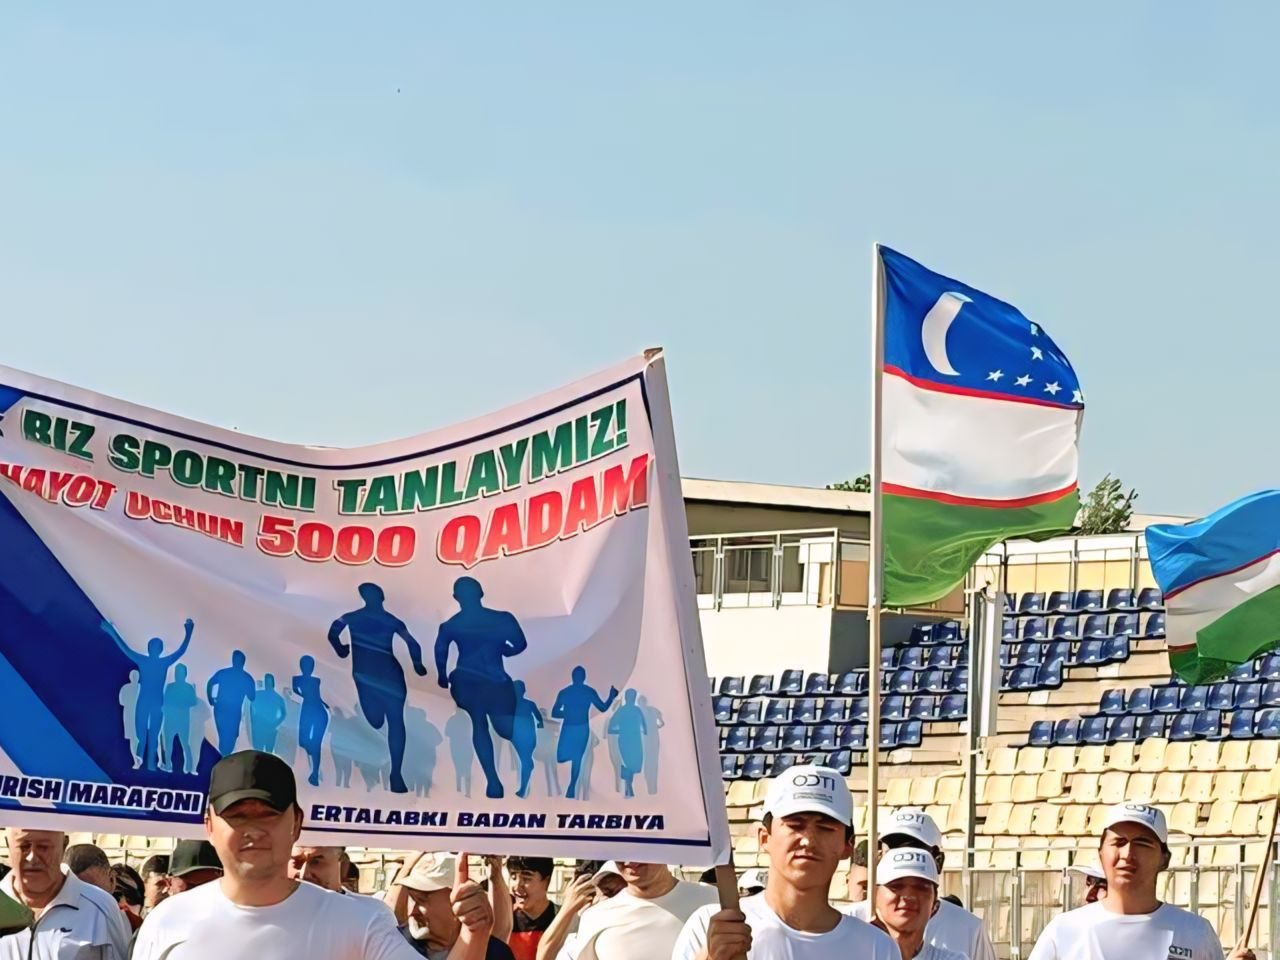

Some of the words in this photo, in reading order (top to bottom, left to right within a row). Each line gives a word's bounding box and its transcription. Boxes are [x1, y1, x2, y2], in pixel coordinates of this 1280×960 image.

[22, 408, 95, 460] BIZ
[108, 432, 316, 512] SPORTNI
[334, 398, 629, 515] TANLAYMIZ!
[124, 490, 244, 548] UCHUN
[257, 514, 415, 567] 5000
[436, 453, 650, 569] QADAM
[68, 780, 204, 816] MARAFONI
[310, 804, 448, 828] ERTALABKI
[457, 812, 547, 830] BADAN
[555, 813, 666, 831] TARBIYA
